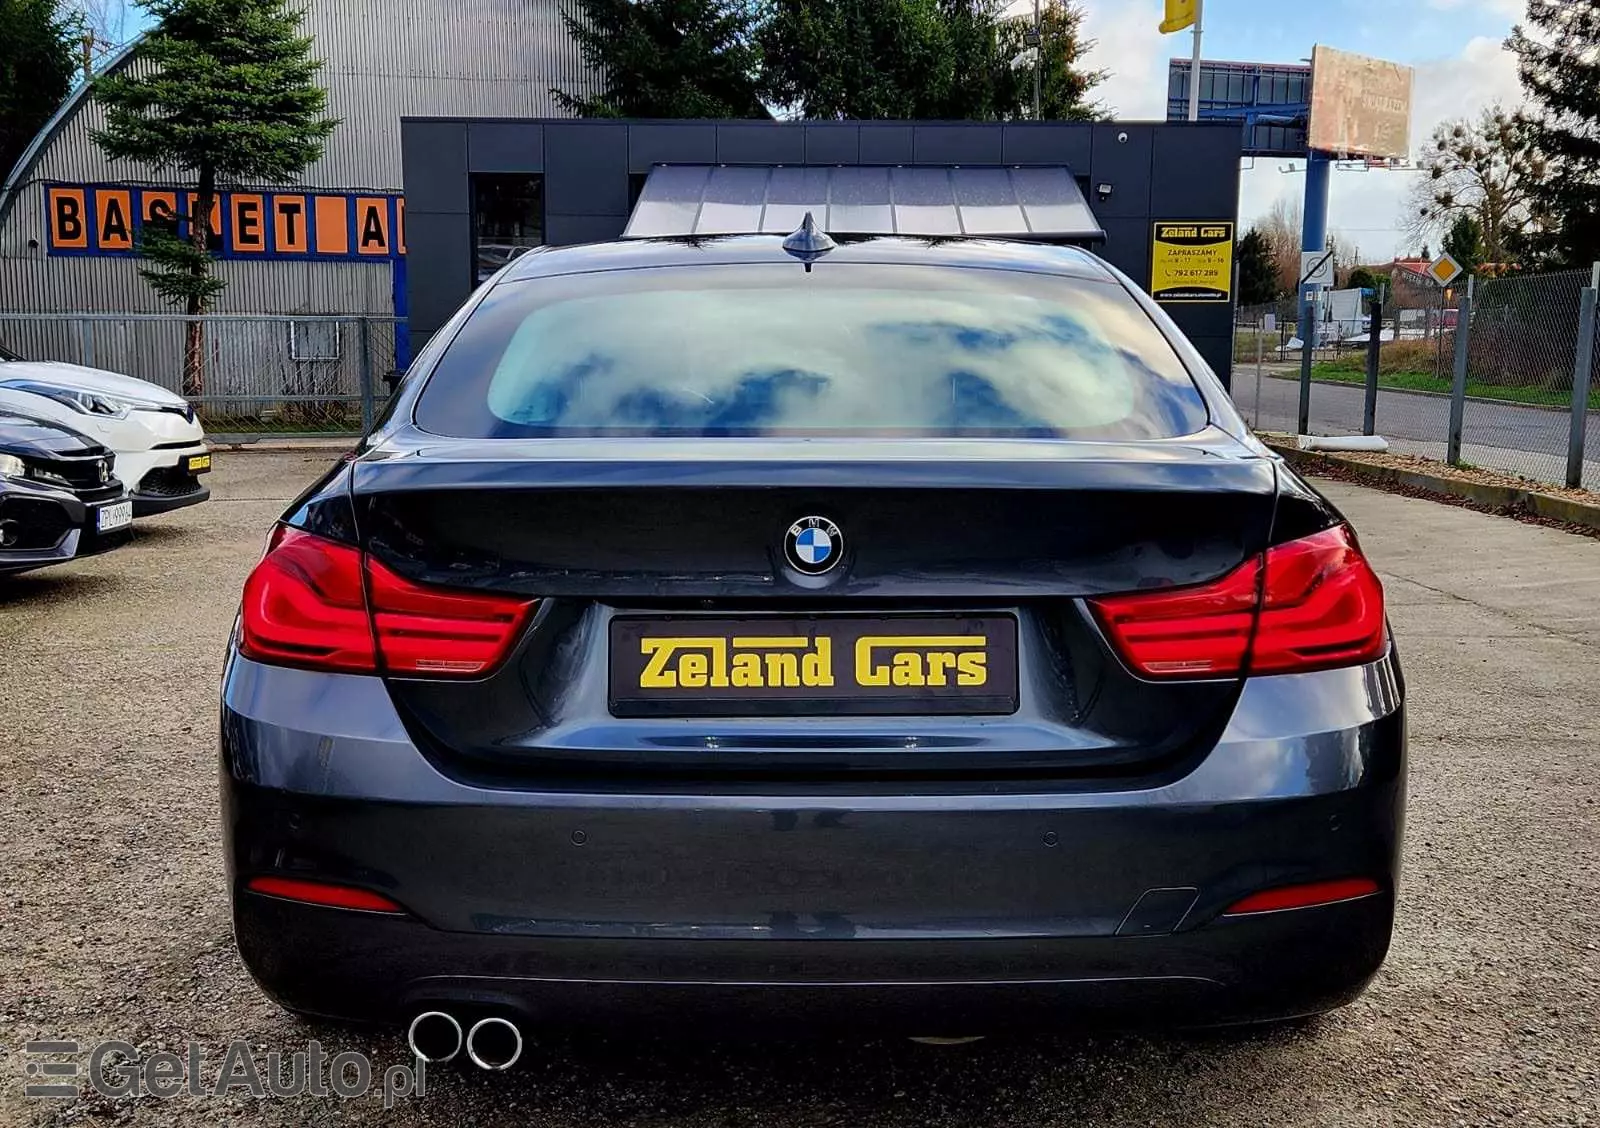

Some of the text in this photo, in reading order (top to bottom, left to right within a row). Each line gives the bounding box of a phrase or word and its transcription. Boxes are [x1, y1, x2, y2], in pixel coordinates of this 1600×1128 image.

[361, 206, 405, 247] A
[1161, 227, 1226, 238] Zeland Cars
[790, 518, 838, 537] BMW
[639, 636, 988, 688] Zeland Cars
